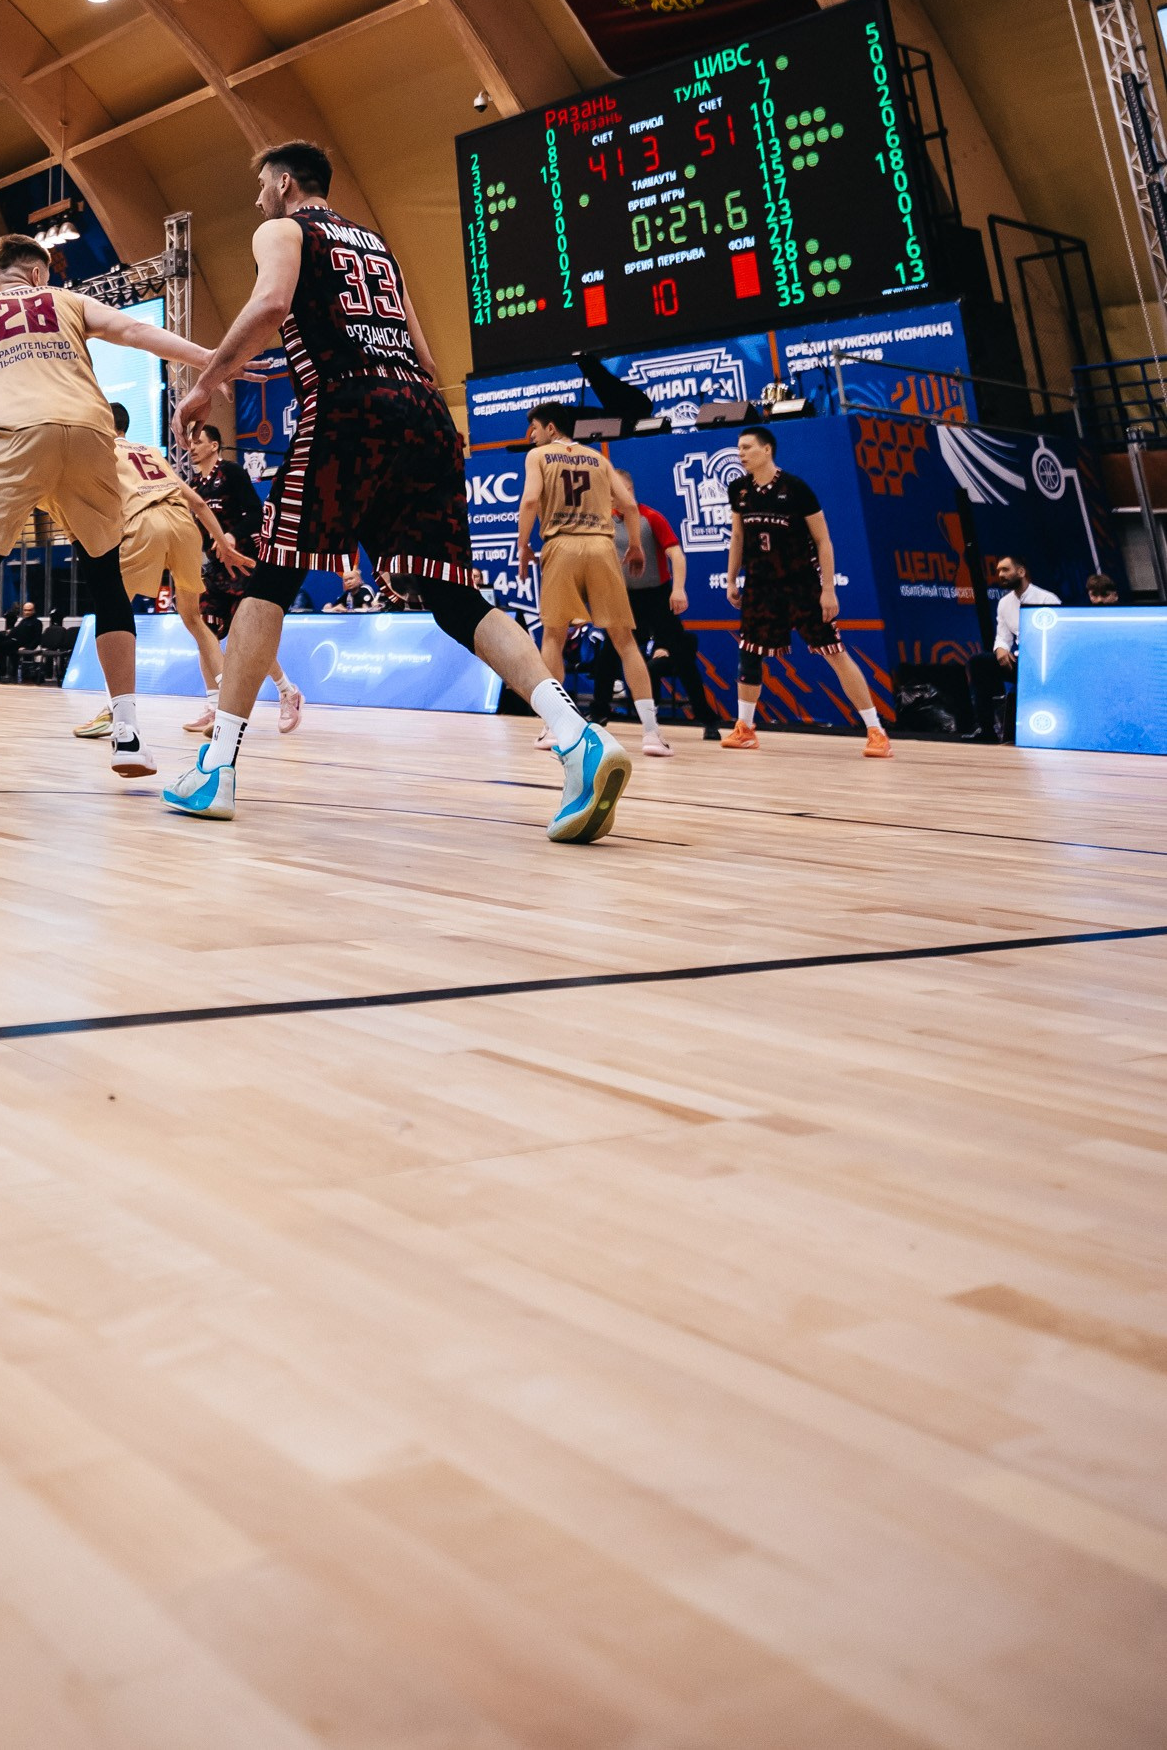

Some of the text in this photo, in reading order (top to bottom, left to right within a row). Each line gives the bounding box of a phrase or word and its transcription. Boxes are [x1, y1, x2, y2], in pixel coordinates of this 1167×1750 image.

[865, 21, 879, 44] 5
[694, 42, 751, 79] ЦИВС
[869, 43, 883, 65] 0
[757, 59, 766, 78] 1
[873, 64, 887, 85] 0
[673, 79, 711, 103] ТУЛА
[758, 77, 770, 99] 7
[877, 85, 892, 107] 2
[698, 96, 722, 113] СЧЕТ
[750, 98, 775, 122] 10
[629, 114, 664, 134] ПЕРИОД
[881, 105, 895, 127] 0
[546, 129, 555, 146] 0
[592, 130, 613, 146] СЧЕТ
[694, 113, 735, 157] 51
[753, 118, 776, 142] 11
[885, 126, 900, 148] 6
[547, 146, 557, 163] 8
[642, 135, 660, 172] 3
[756, 137, 781, 162] 13
[471, 154, 479, 170] 2
[588, 148, 624, 181] 41
[759, 157, 785, 182] 15
[875, 148, 904, 174] 18
[472, 170, 481, 187] 3
[540, 162, 560, 184] 15
[893, 170, 908, 192] 0
[473, 187, 483, 203] 5
[551, 181, 562, 198] 0
[627, 187, 685, 212] ВРЕМЯ ИГРЫ
[762, 177, 786, 202] 17
[474, 203, 484, 220] 9
[553, 198, 563, 217] 9
[764, 198, 791, 223] 23
[897, 192, 912, 214] 0
[468, 220, 485, 239] 12
[555, 216, 565, 235] 0
[631, 189, 748, 253] 0:27.6
[767, 218, 793, 244] 27
[902, 213, 913, 236] 1
[315, 222, 386, 252] ХАМИТОВ
[469, 237, 487, 255] 13
[557, 234, 567, 252] 0
[905, 235, 921, 259] 6
[471, 253, 489, 273] 14
[559, 252, 569, 271] 0
[624, 246, 706, 275] ВРЕМЯ ПЕРЕРЫВА
[771, 239, 798, 265] 28
[471, 272, 489, 291] 21
[560, 270, 571, 289] 7
[774, 261, 799, 286] 31
[895, 259, 925, 284] 13
[331, 247, 406, 321] 33
[777, 282, 805, 307] 35
[473, 289, 492, 309] 33
[562, 289, 574, 309] 2
[652, 278, 679, 316] 10
[474, 307, 492, 326] 41
[785, 340, 827, 359] СРЕДИ
[894, 320, 953, 343] КОМАНД
[37, 351, 79, 361] ОБЛАСТИ
[646, 361, 713, 379] ЧЕМПИОНАТ ЦФО
[472, 387, 523, 403] ЧЕМПИОНАТ
[644, 377, 698, 402] ИНАЛ
[128, 453, 167, 481] 15
[545, 453, 600, 467] ВИНОКУРОВ
[894, 549, 956, 585] ЦЕЛЬ
